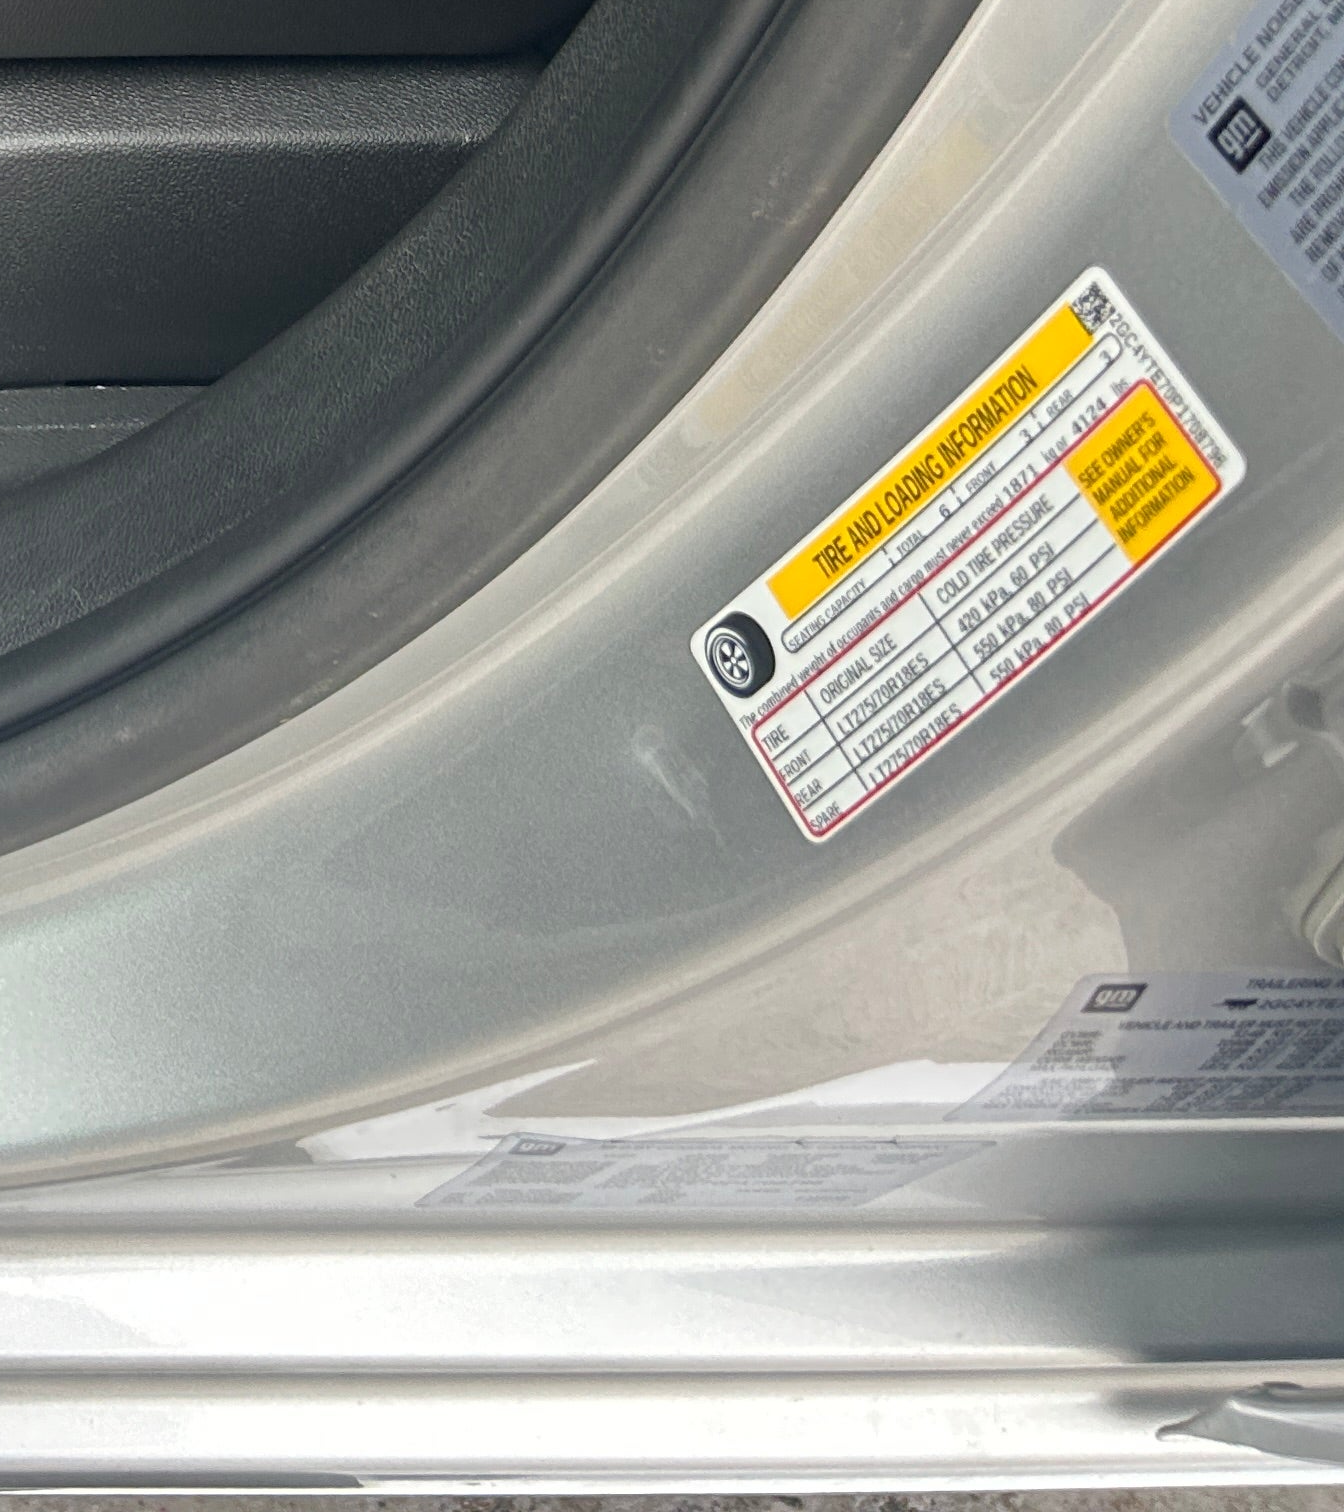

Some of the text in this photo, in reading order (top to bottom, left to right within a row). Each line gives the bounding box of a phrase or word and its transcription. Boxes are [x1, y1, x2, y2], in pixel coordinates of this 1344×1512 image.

[1191, 44, 1261, 125] VEHICLE
[787, 612, 827, 653] SEATING
[823, 576, 867, 621] CAPACITY
[895, 526, 925, 557] TOTAL
[936, 502, 951, 520] 6
[964, 460, 998, 494] FRONT
[1018, 426, 1034, 445] 3
[1044, 388, 1074, 419] REAR
[811, 363, 1040, 582] TIRE AND LOADING INFORMATION
[1076, 409, 1158, 490] SEE OWNER'S
[1090, 429, 1169, 506] MANUAL FOR
[1105, 450, 1180, 522] ADDITIONAL
[1114, 464, 1198, 544] INFORMATION
[739, 708, 758, 730] The
[754, 672, 799, 718] combined
[794, 649, 829, 686] weight
[823, 640, 837, 658] of
[834, 603, 883, 652] occupants
[878, 588, 900, 612] and
[897, 567, 926, 599] cargo
[921, 546, 948, 574] must
[945, 525, 973, 553] never
[967, 493, 1005, 531] exceed
[1001, 462, 1039, 500] 1871
[1039, 443, 1059, 466] kg
[1053, 434, 1070, 452] or
[1066, 395, 1109, 437] 4124
[761, 492, 1054, 755] TIRE ORIGINAL SIZE COLD TIRE PRESSURE
[778, 747, 813, 783] FRONT
[835, 647, 930, 739] LT275/70R18ES
[955, 605, 983, 635] 420
[1008, 563, 1030, 588] 60
[1027, 541, 1056, 571] PSI
[793, 776, 823, 808] REAR
[851, 674, 947, 765] LT275/70R18ES
[971, 630, 1000, 661] 550
[1025, 588, 1048, 614] 80
[1044, 566, 1074, 597] PSI
[809, 799, 842, 834] SPARE
